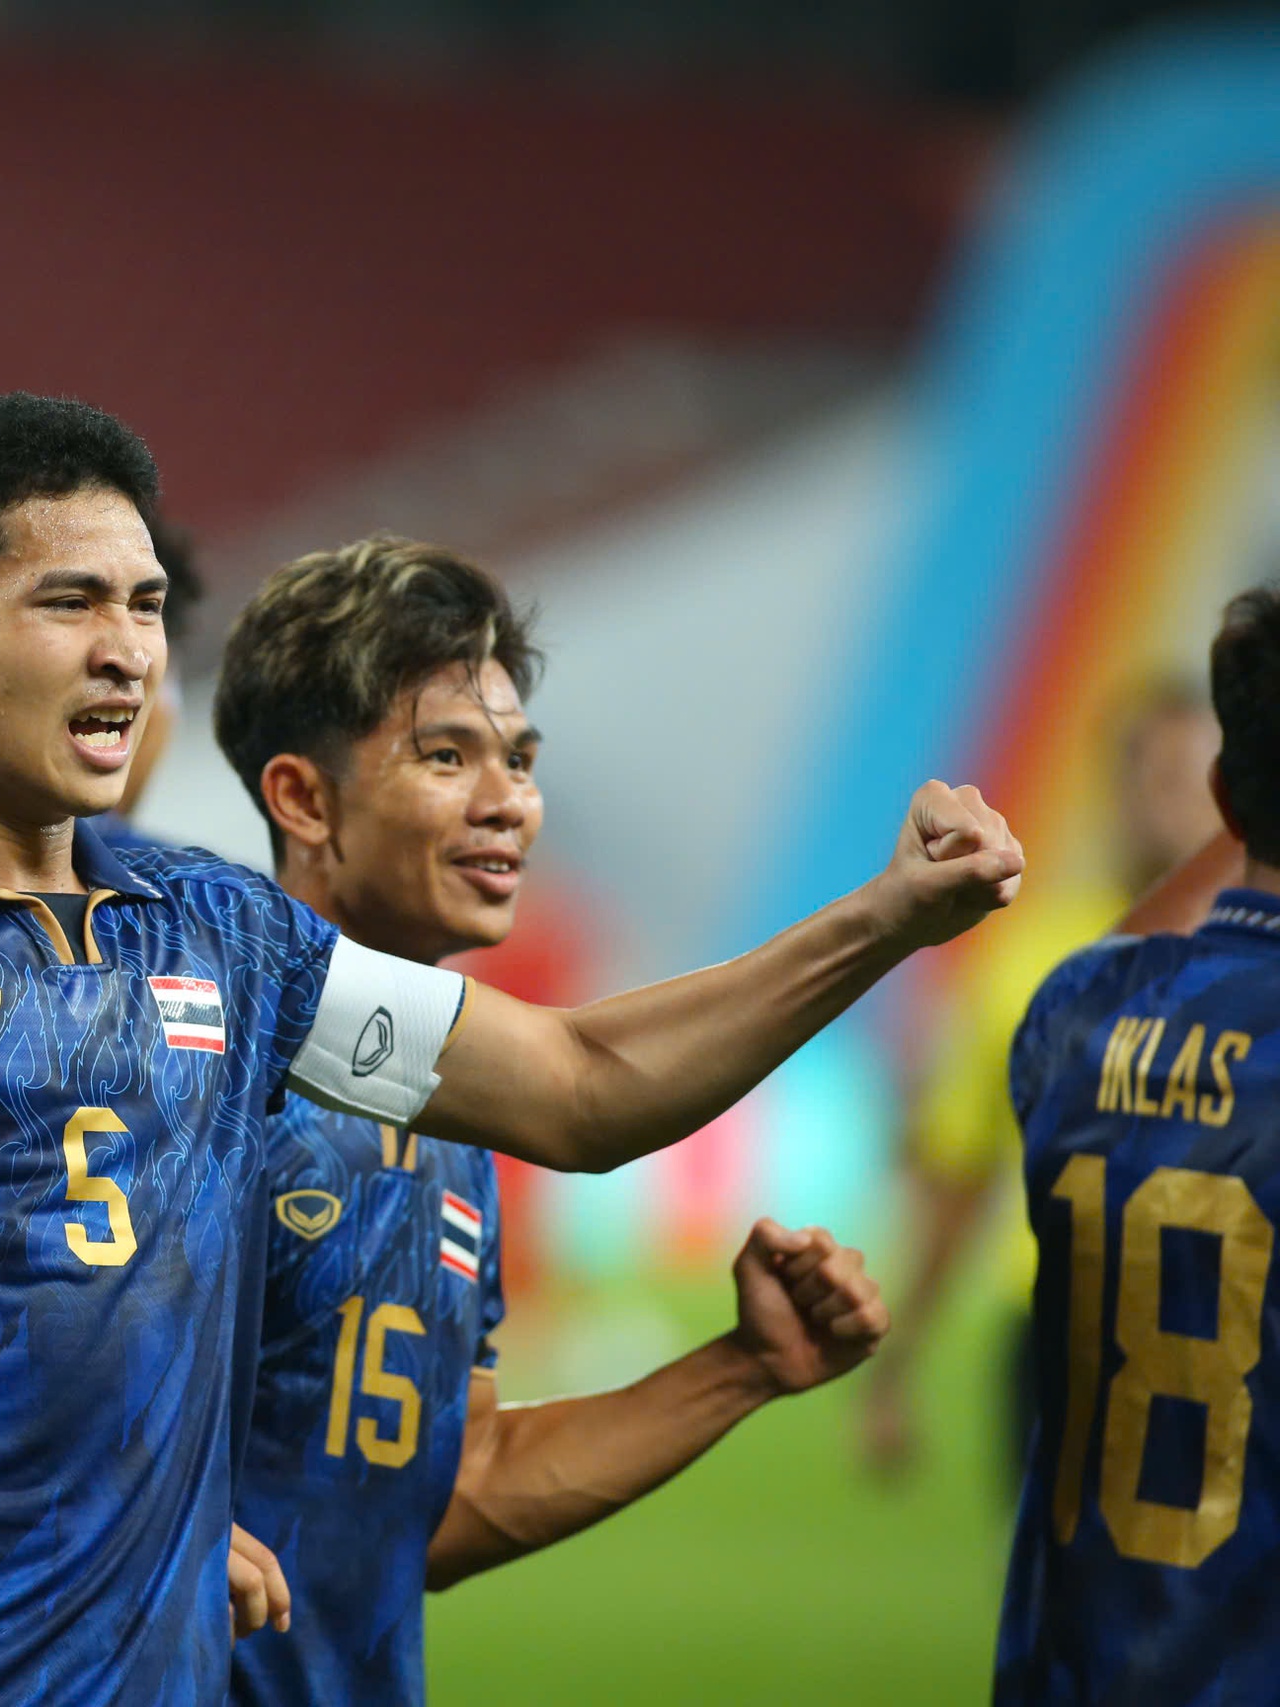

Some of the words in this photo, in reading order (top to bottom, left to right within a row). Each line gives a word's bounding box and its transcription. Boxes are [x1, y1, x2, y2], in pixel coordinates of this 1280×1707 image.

[1096, 1015, 1253, 1128] IKLAS
[63, 1106, 138, 1266] 5
[325, 1296, 427, 1469] 15
[1051, 1152, 1275, 1569] 18
